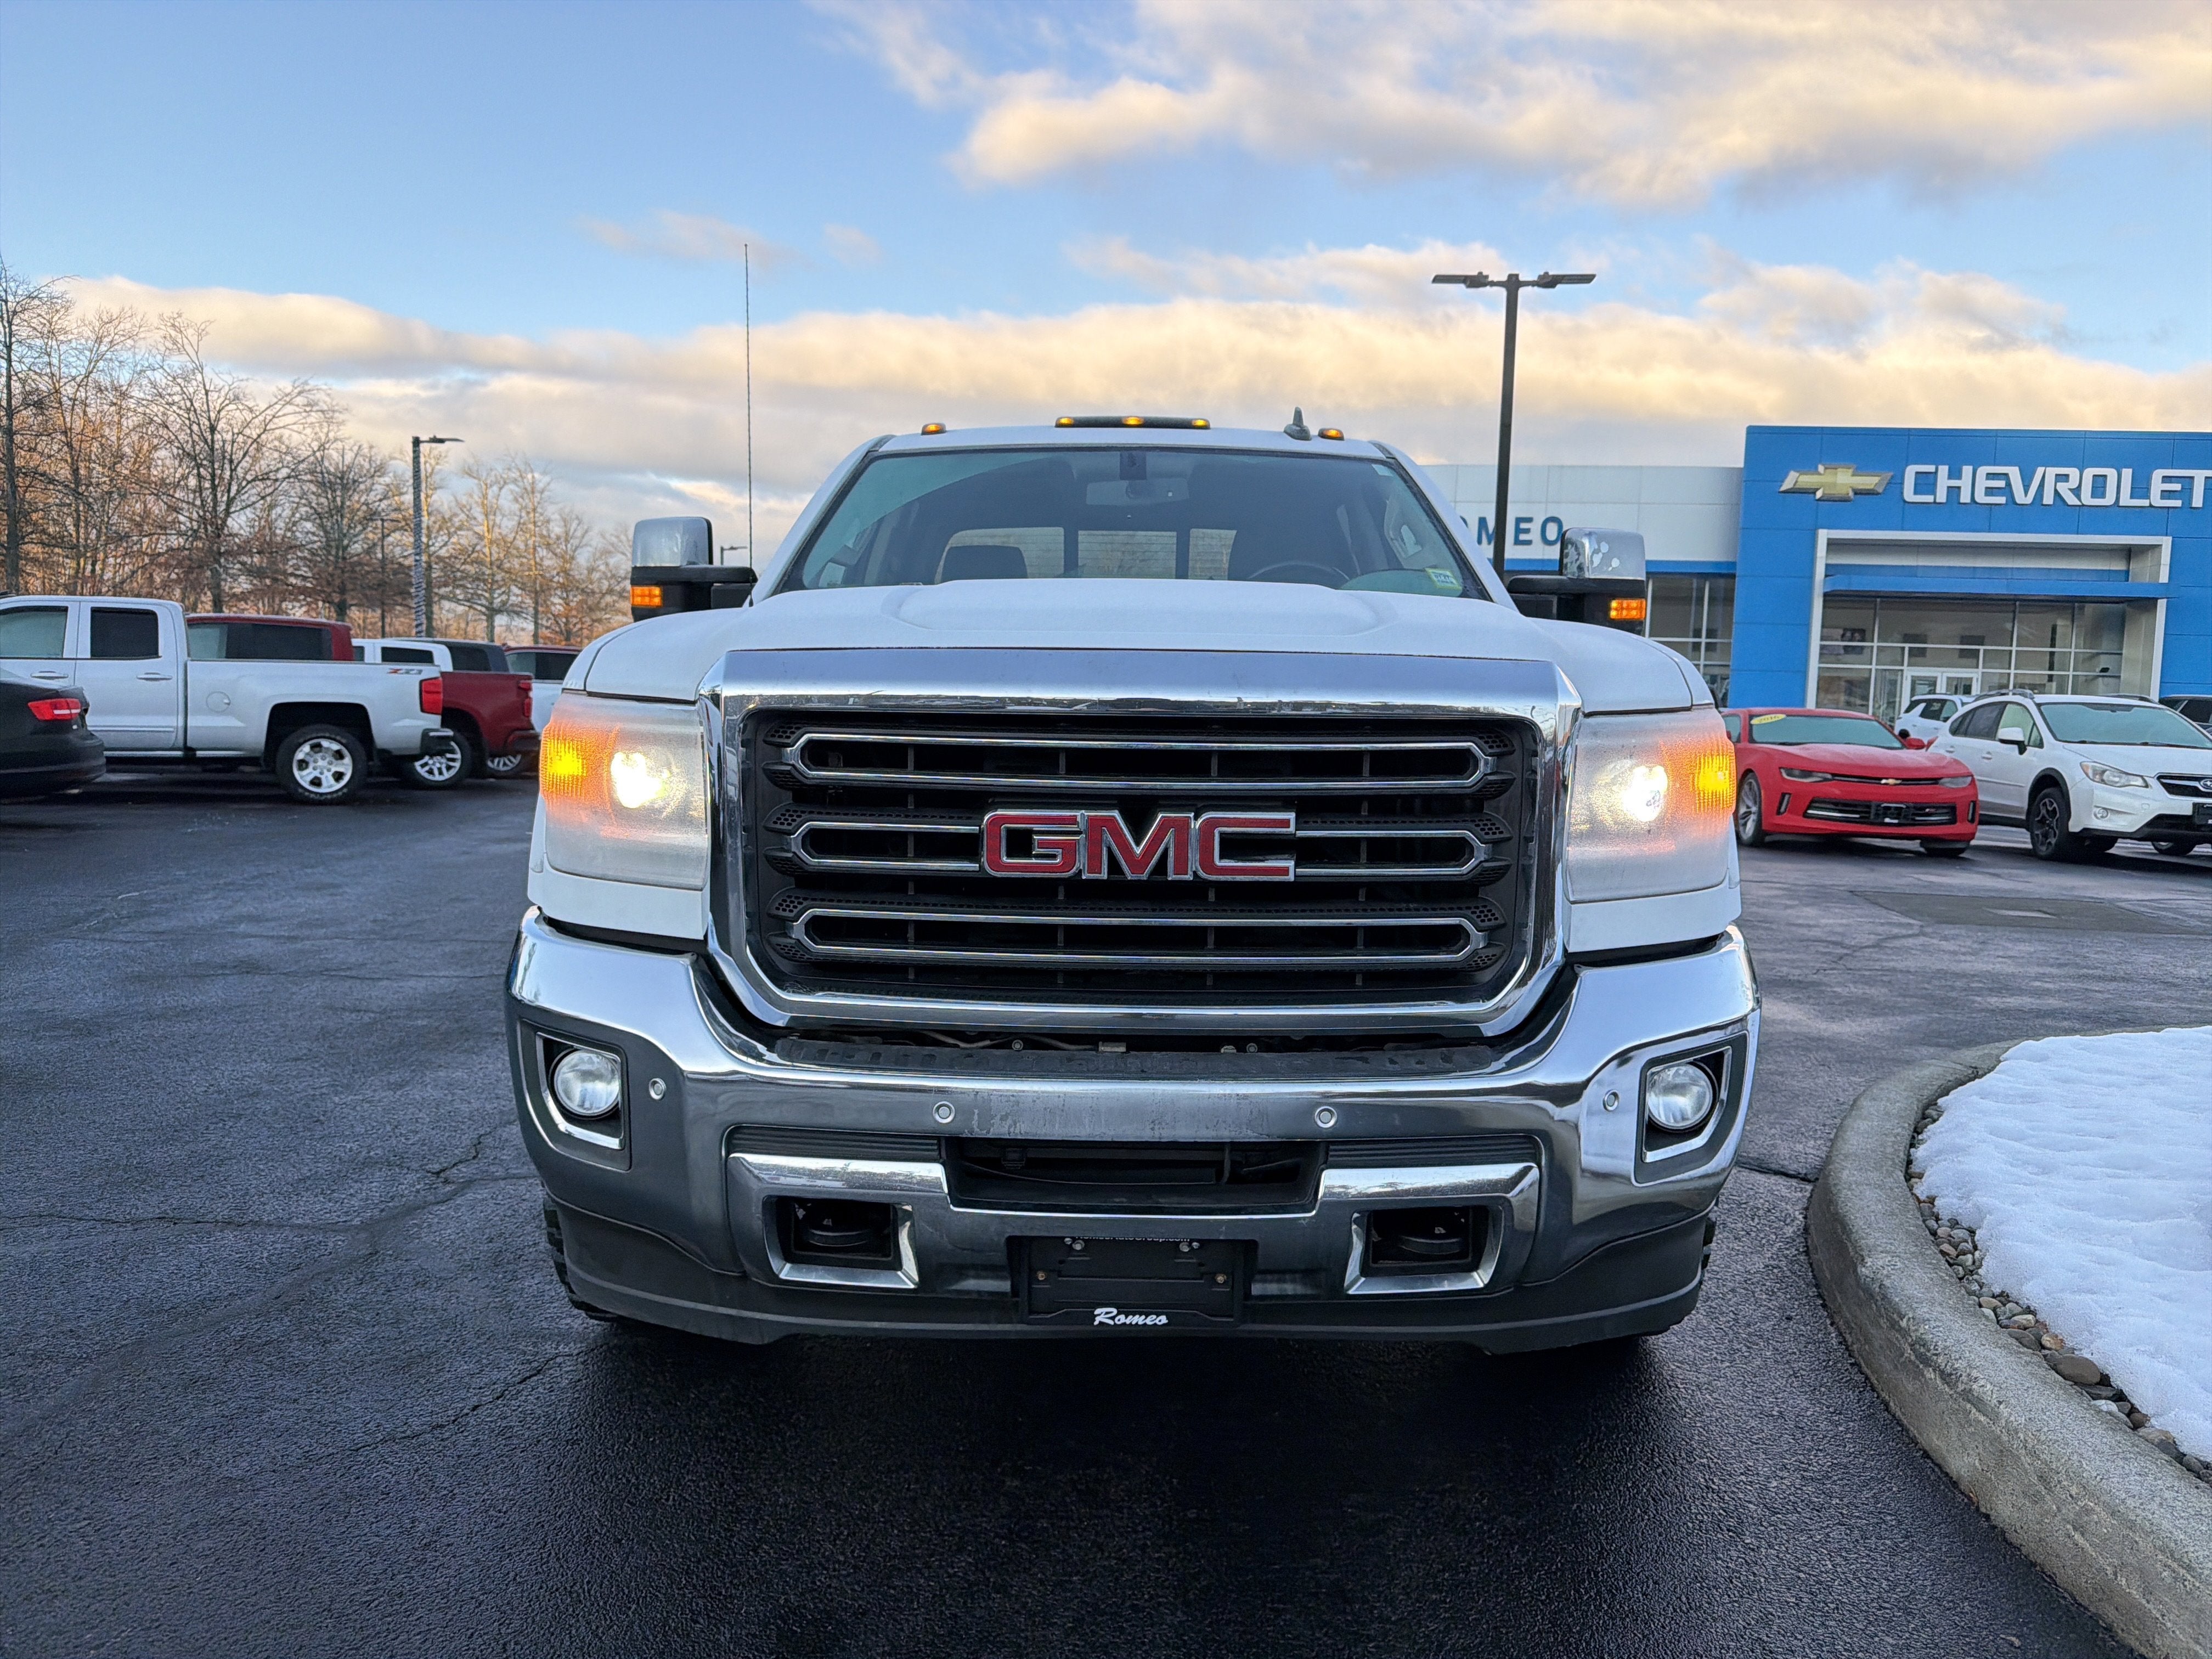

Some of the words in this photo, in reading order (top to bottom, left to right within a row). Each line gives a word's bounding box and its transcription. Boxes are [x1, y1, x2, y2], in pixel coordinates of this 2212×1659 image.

[1903, 464, 2212, 508] CHEVROLET
[983, 809, 1296, 882] GMC
[1093, 1307, 1169, 1325] Romeo
